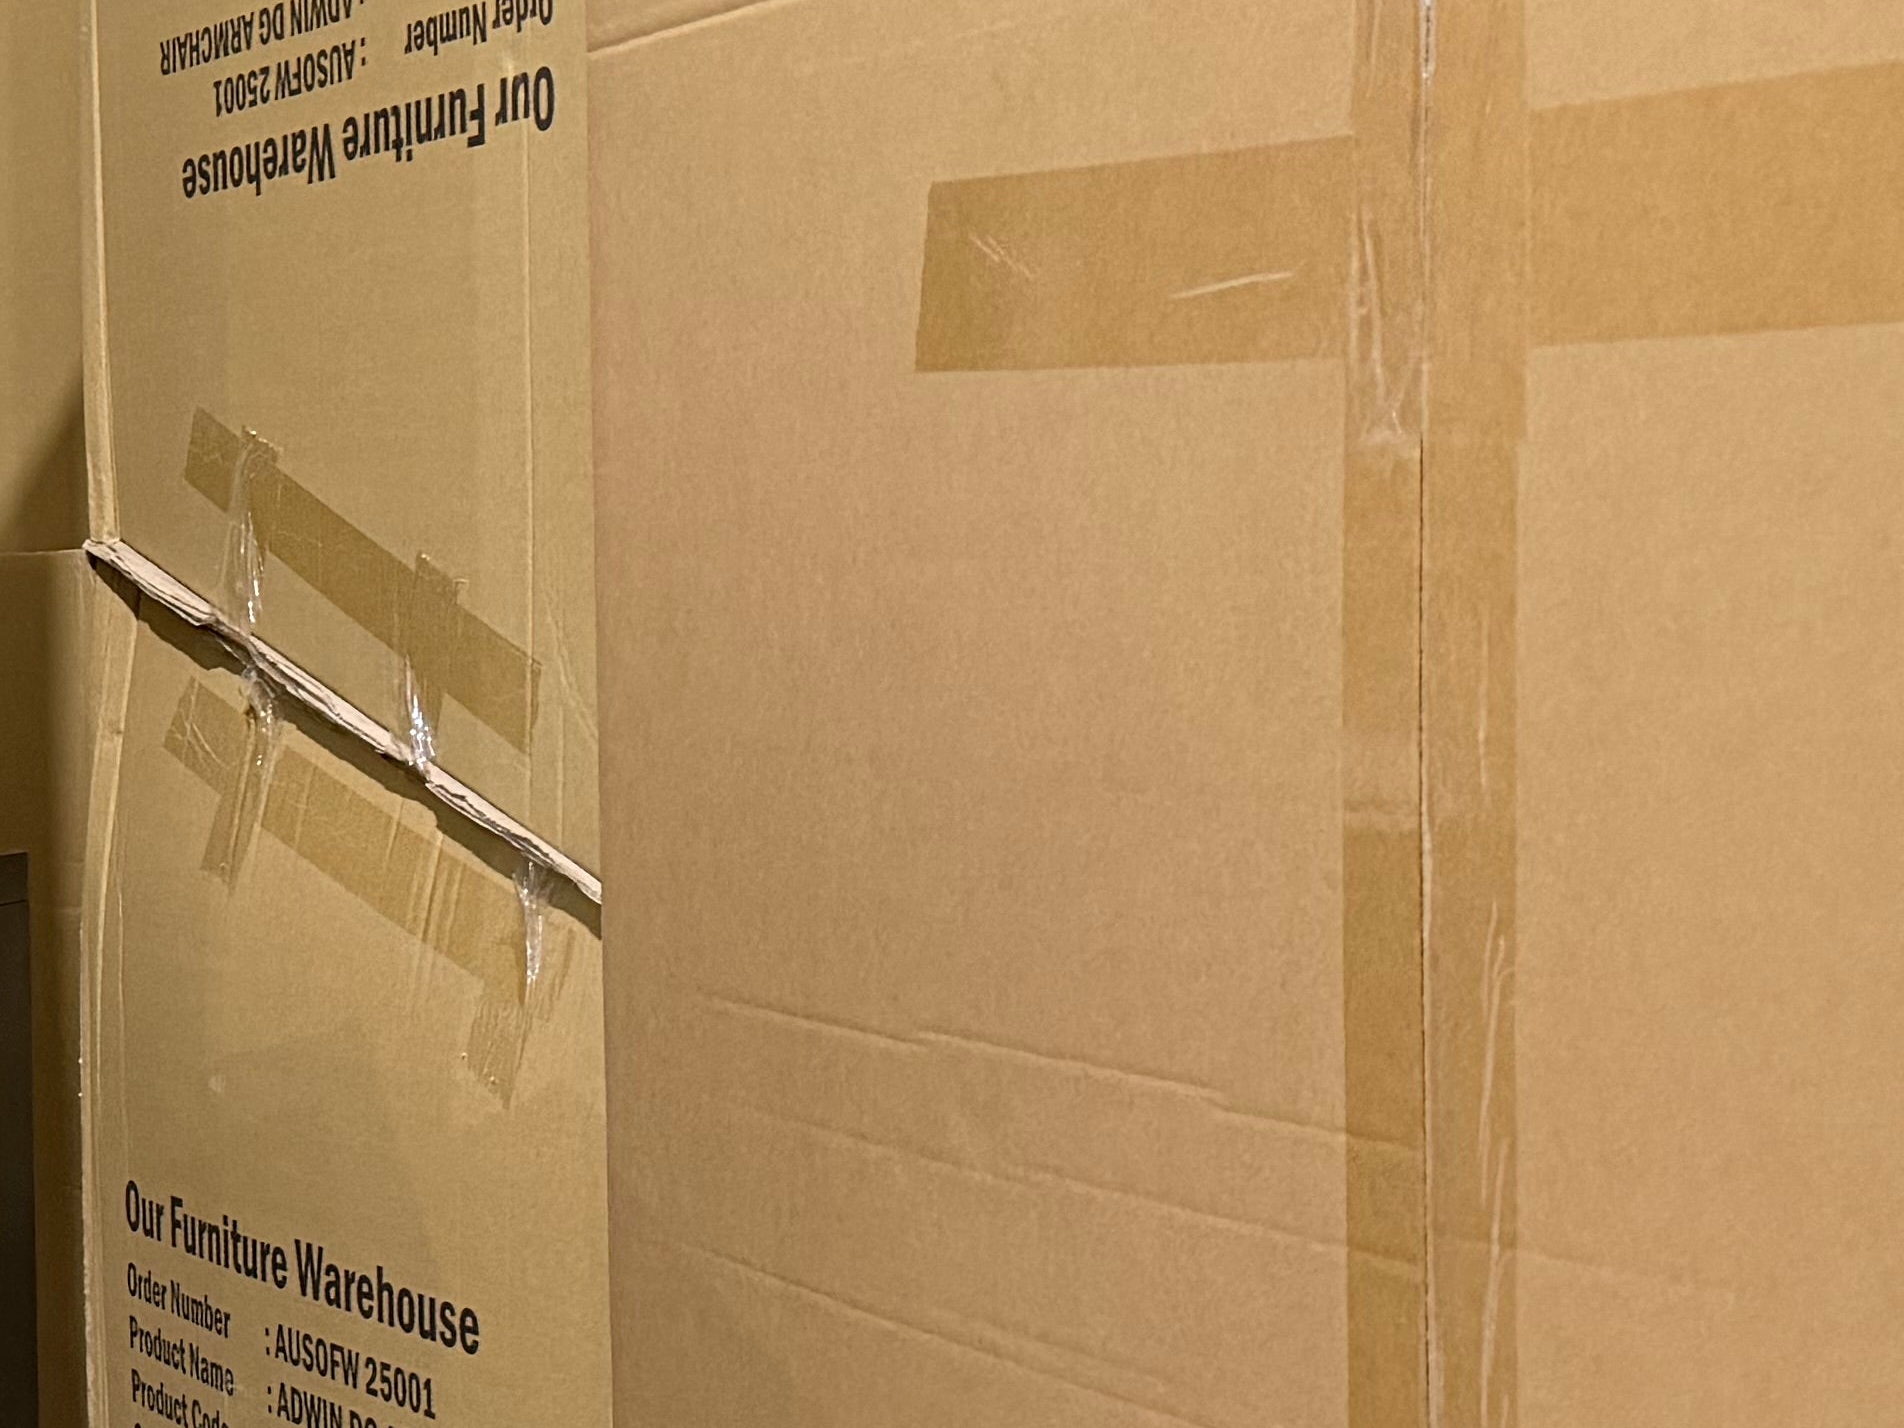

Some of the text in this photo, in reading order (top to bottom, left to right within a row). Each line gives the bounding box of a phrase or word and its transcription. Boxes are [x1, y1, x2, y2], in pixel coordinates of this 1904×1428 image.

[182, 66, 554, 198] Our Furniture Warehouse
[125, 1180, 479, 1355] Our Furniture Warehouse
[127, 1262, 436, 1420] Order Number AUSOFW 25001
[129, 1315, 186, 1374] Product
[189, 1343, 234, 1396] Name
